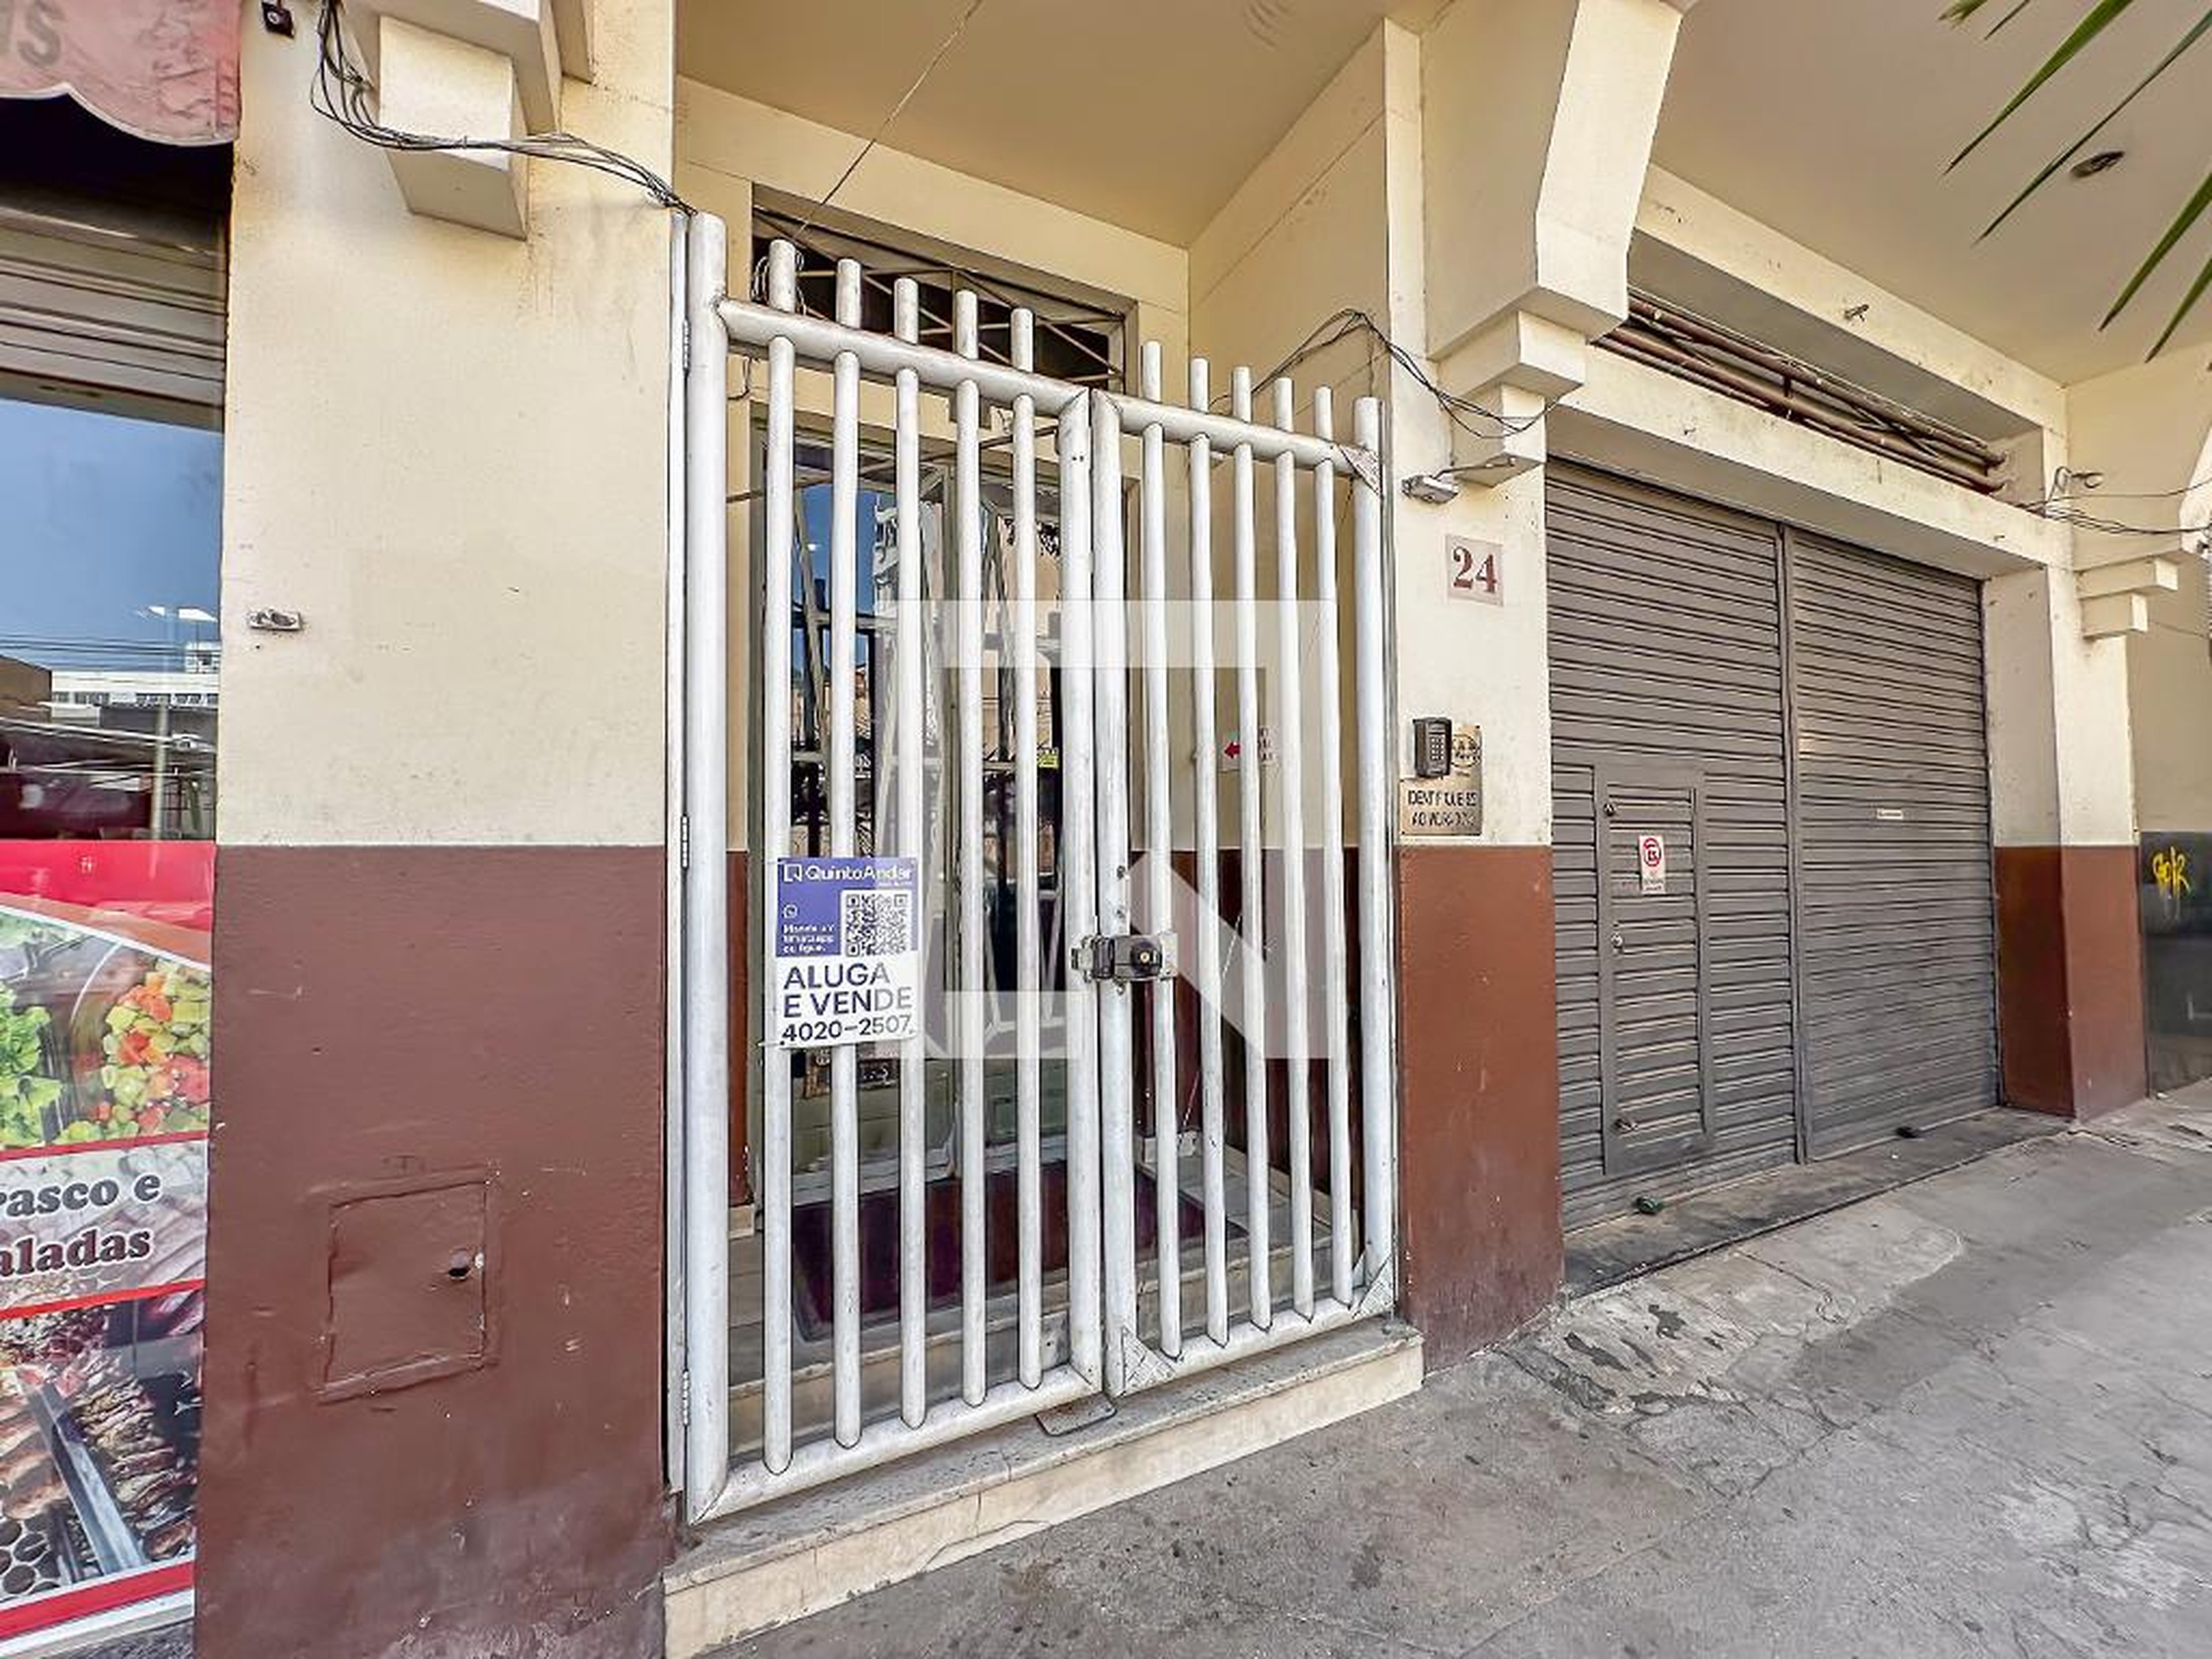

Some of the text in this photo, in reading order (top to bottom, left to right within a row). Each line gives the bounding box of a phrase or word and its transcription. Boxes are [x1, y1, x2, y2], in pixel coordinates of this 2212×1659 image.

[0, 0, 65, 68] S
[1453, 546, 1497, 594] 24
[806, 865, 911, 880] QuintoAndar
[783, 963, 891, 990] ALUGA
[784, 986, 912, 1018] E VENDE
[782, 1014, 911, 1041] 4020-2507
[134, 1175, 161, 1202] e
